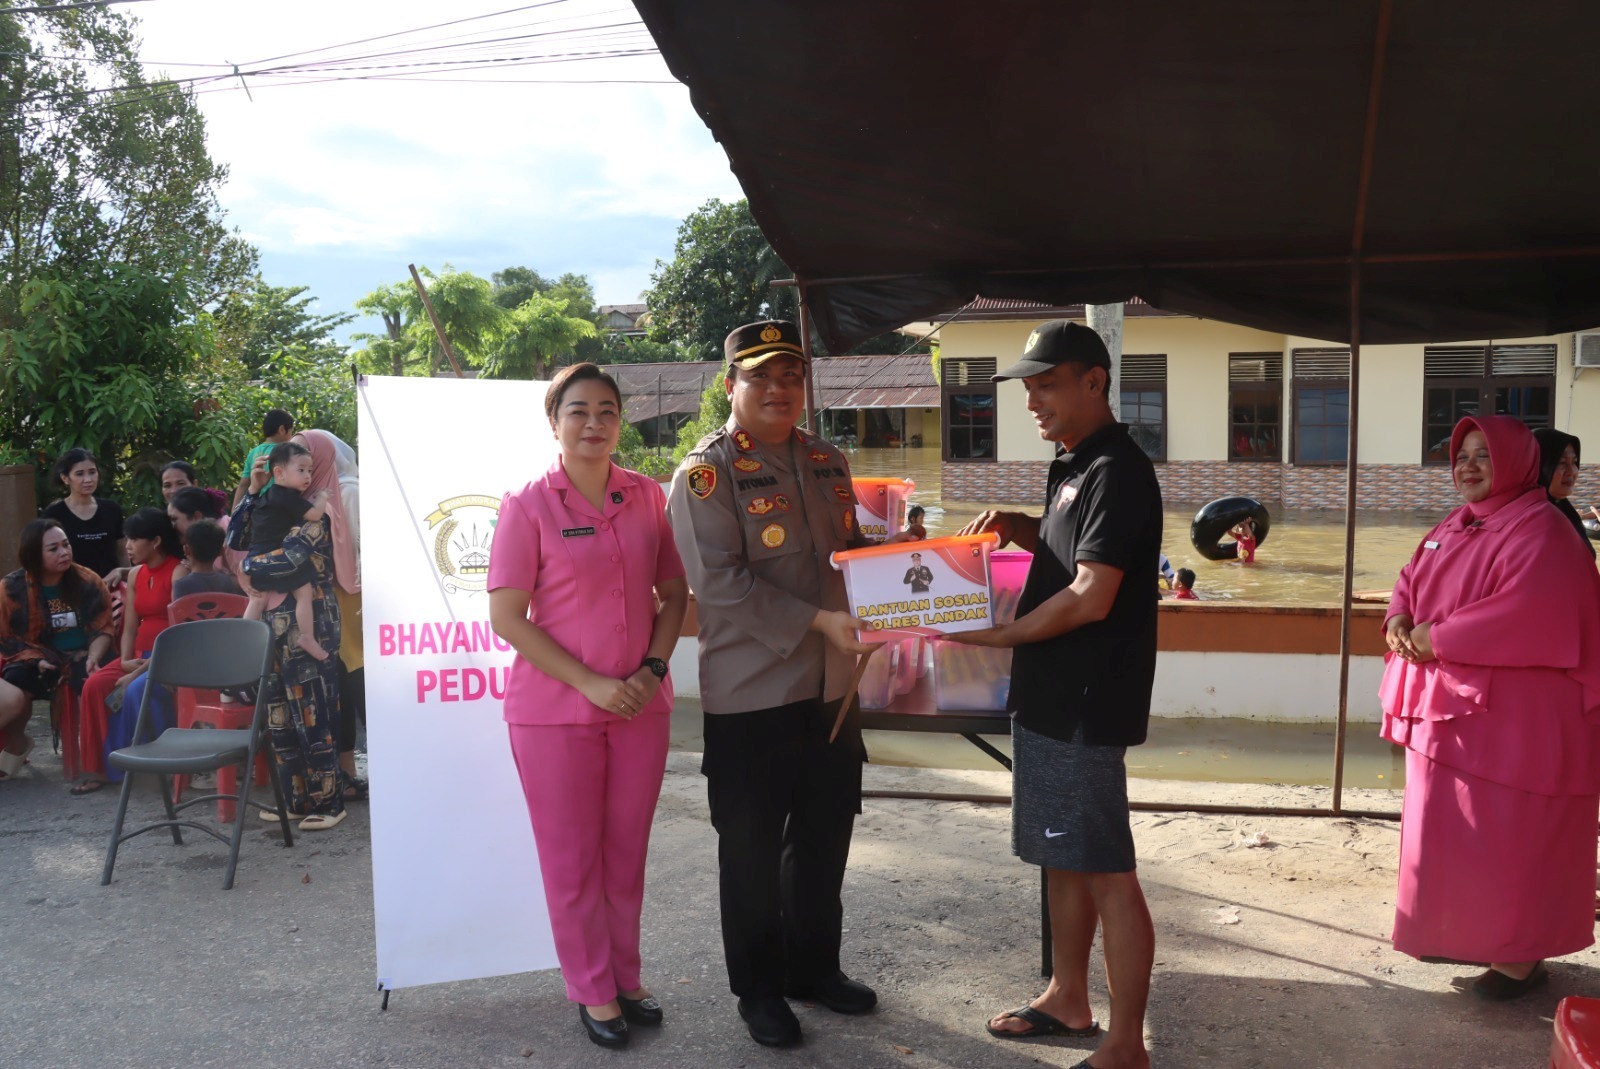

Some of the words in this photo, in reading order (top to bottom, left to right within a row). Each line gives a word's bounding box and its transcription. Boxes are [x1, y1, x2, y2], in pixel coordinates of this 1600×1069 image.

[443, 495, 502, 511] BHAYANGKAR
[859, 524, 888, 535] SIAL
[857, 598, 930, 617] BANTUAN
[934, 592, 988, 609] SOSIAL
[871, 614, 921, 631] OLRES
[924, 606, 988, 625] LANDAK
[379, 620, 512, 656] BHAYANG
[416, 666, 511, 703] PEDU
